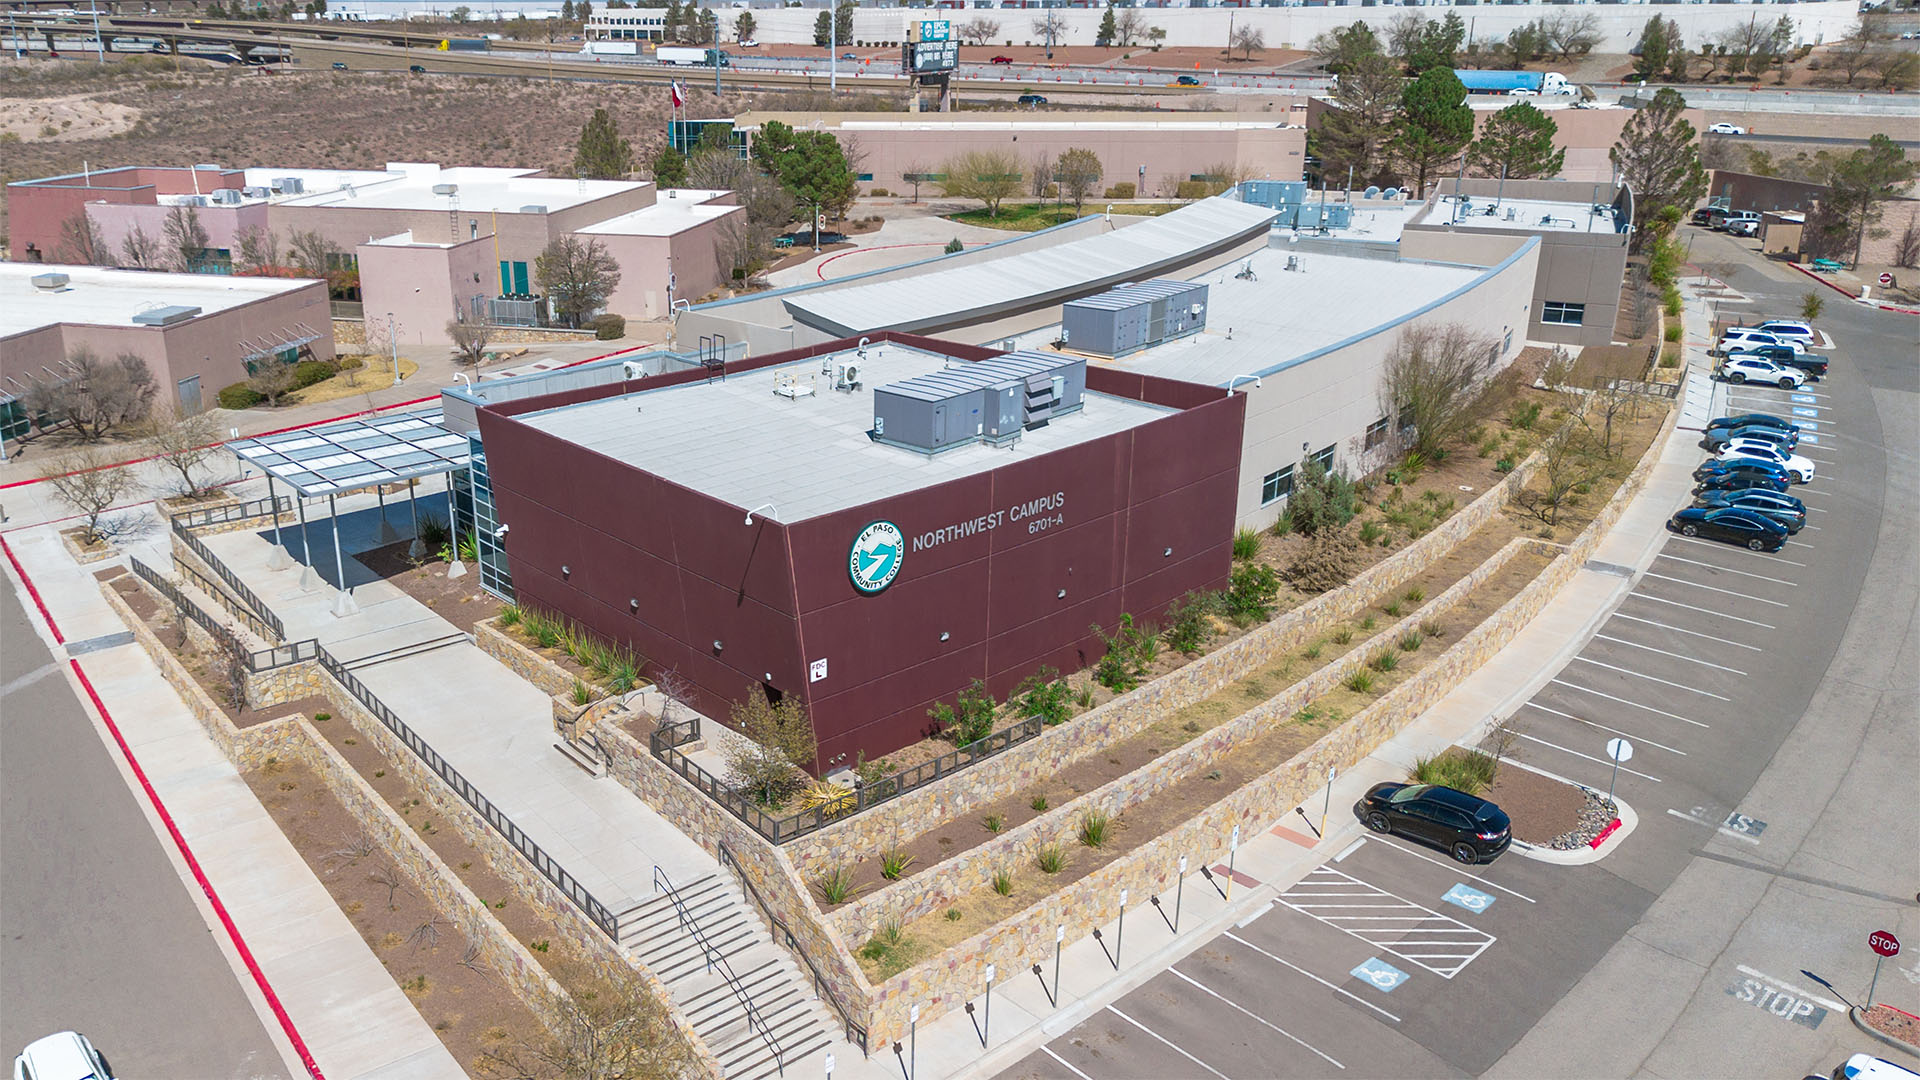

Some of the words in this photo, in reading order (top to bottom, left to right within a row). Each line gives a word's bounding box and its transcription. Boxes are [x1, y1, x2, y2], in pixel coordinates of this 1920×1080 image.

[861, 531, 871, 542] EL
[873, 524, 894, 533] PASO
[913, 511, 1005, 552] NORTHWEST
[1009, 492, 1065, 522] CAMPUS
[1028, 513, 1064, 534] 6701-A
[852, 551, 883, 588] COMMUNITY
[885, 538, 902, 582] COLLEGE
[1870, 934, 1898, 951] STOP
[1735, 979, 1815, 1021] STOP
